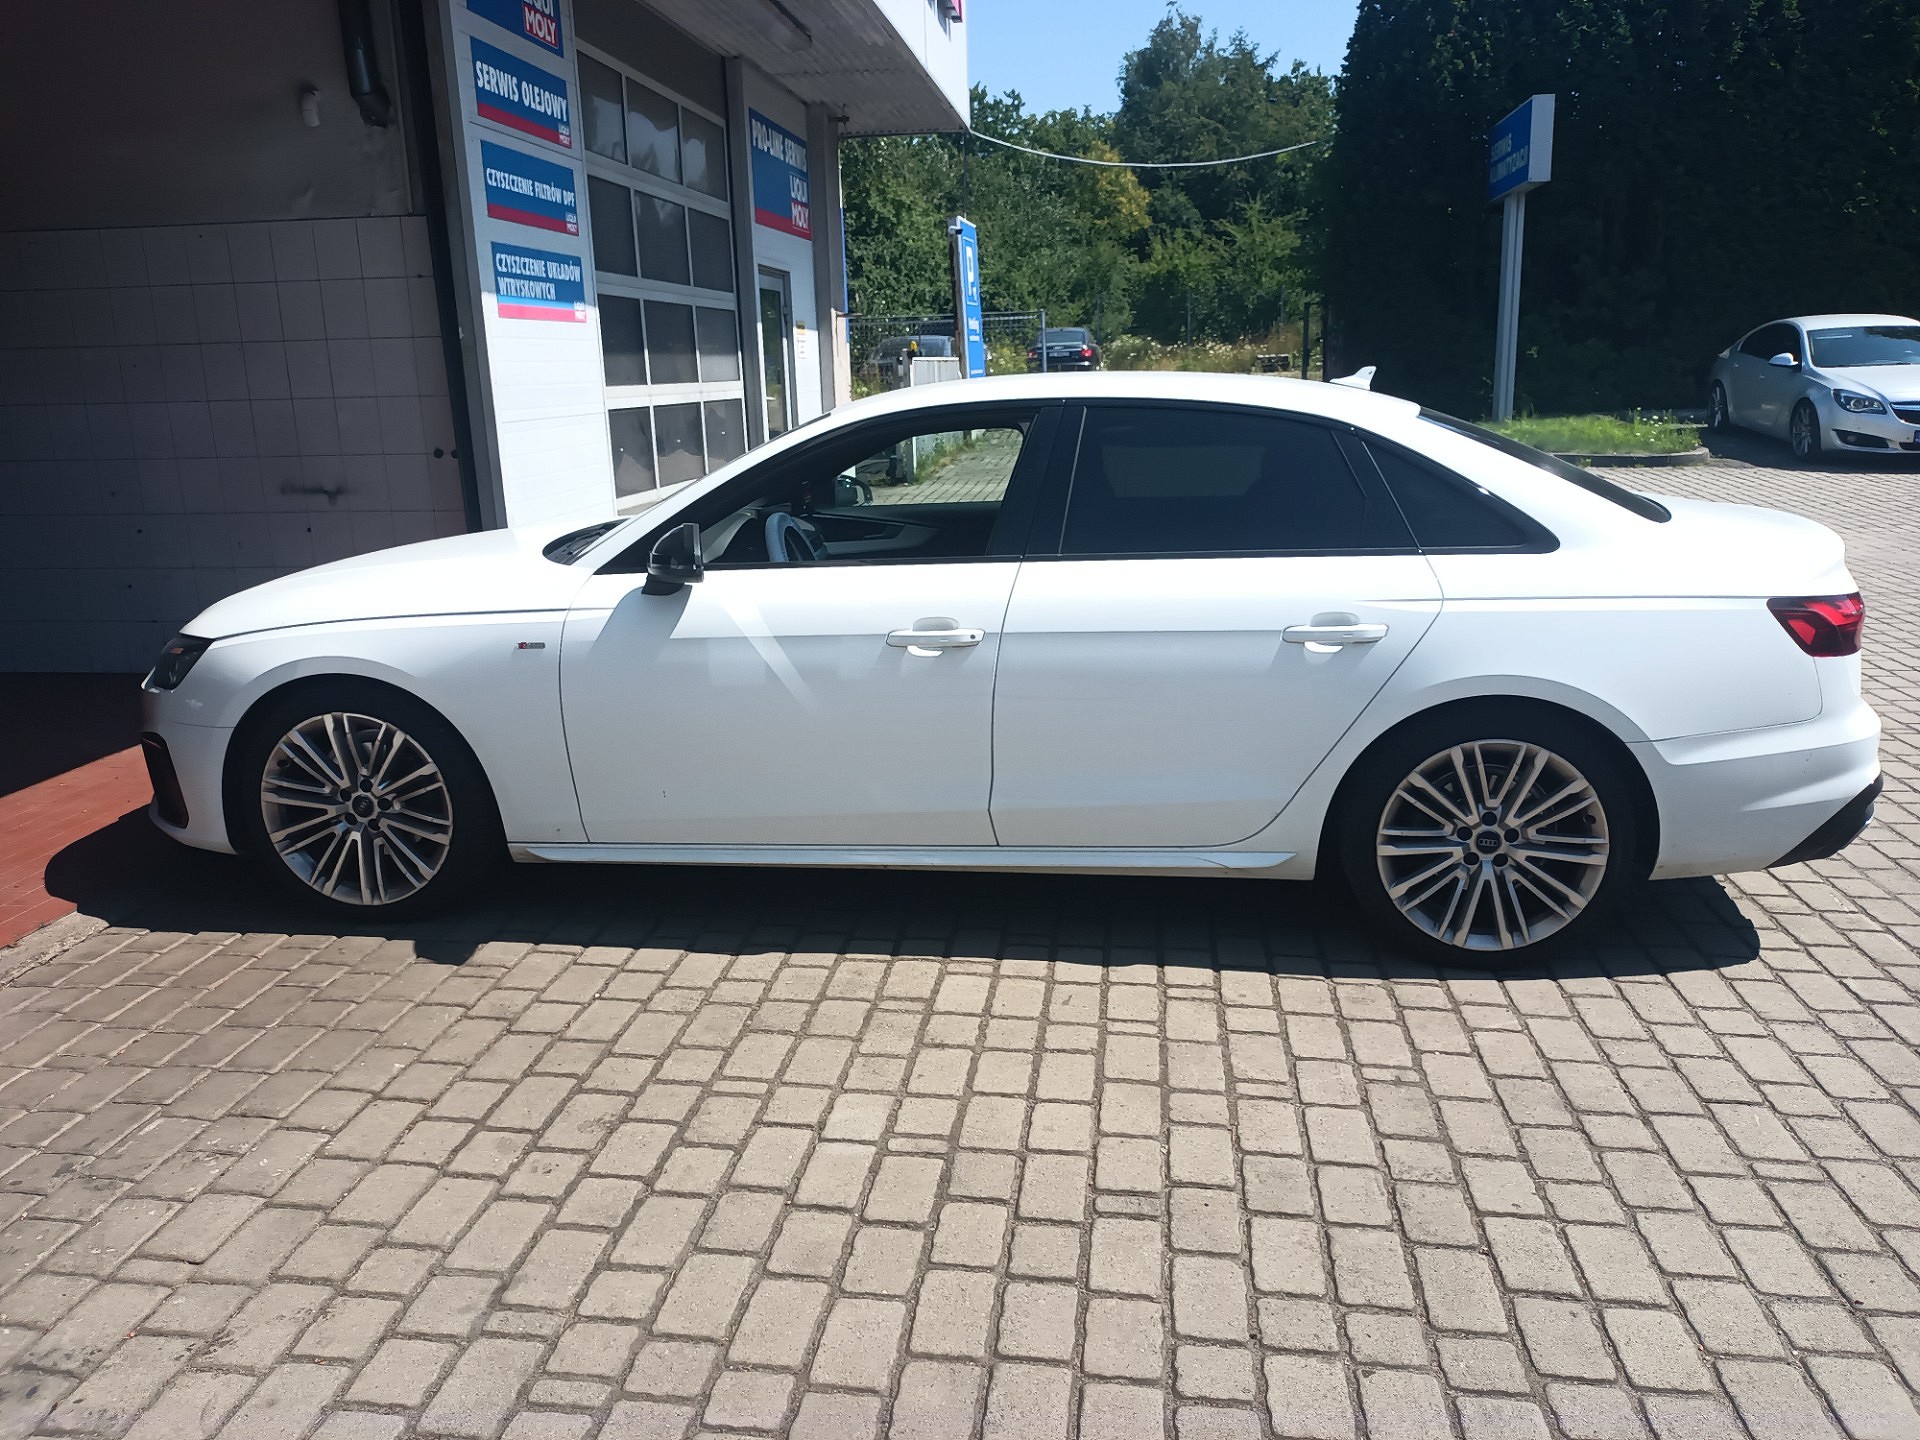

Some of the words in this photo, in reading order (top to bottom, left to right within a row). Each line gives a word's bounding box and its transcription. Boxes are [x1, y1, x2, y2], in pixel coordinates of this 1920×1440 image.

[523, 0, 554, 17] QUI
[524, 6, 556, 44] MOLY
[476, 61, 519, 103] SERWIS
[521, 81, 567, 122] OLEJOWY
[486, 167, 535, 197] CZYSZCZENIE
[534, 181, 562, 204] FILTRÓW
[790, 174, 808, 203] LIQUI
[791, 202, 809, 230] MOLY
[495, 253, 547, 278] CZYSZCZENIE
[497, 276, 556, 301] WTRYSKOWYCH
